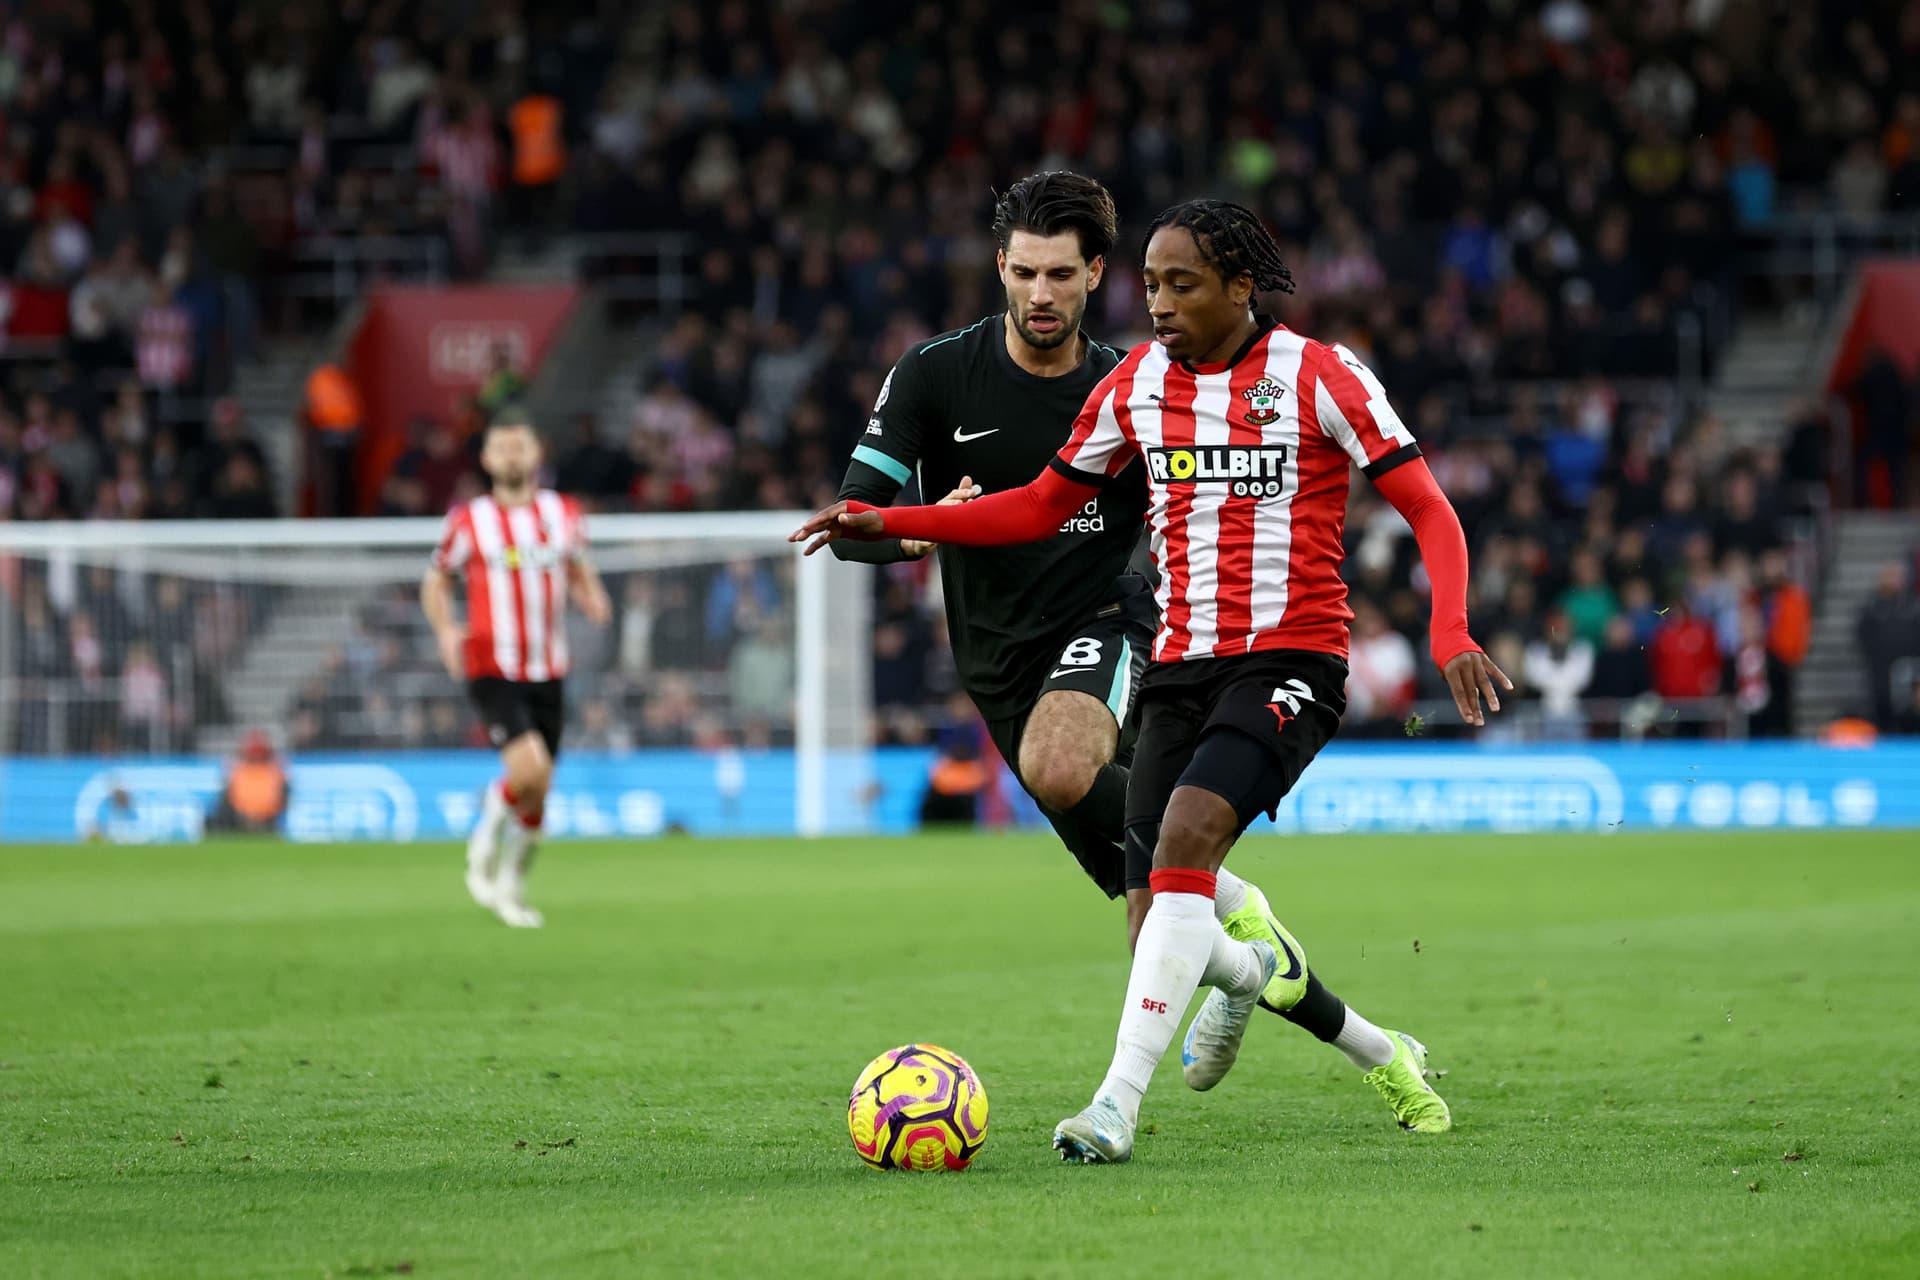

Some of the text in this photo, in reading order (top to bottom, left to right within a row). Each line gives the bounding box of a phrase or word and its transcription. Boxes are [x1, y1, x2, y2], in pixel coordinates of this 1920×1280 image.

[1150, 450, 1282, 479] ROLLBIT
[1060, 637, 1103, 665] 8
[1271, 679, 1316, 715] 2
[1142, 998, 1167, 1014] SFC
